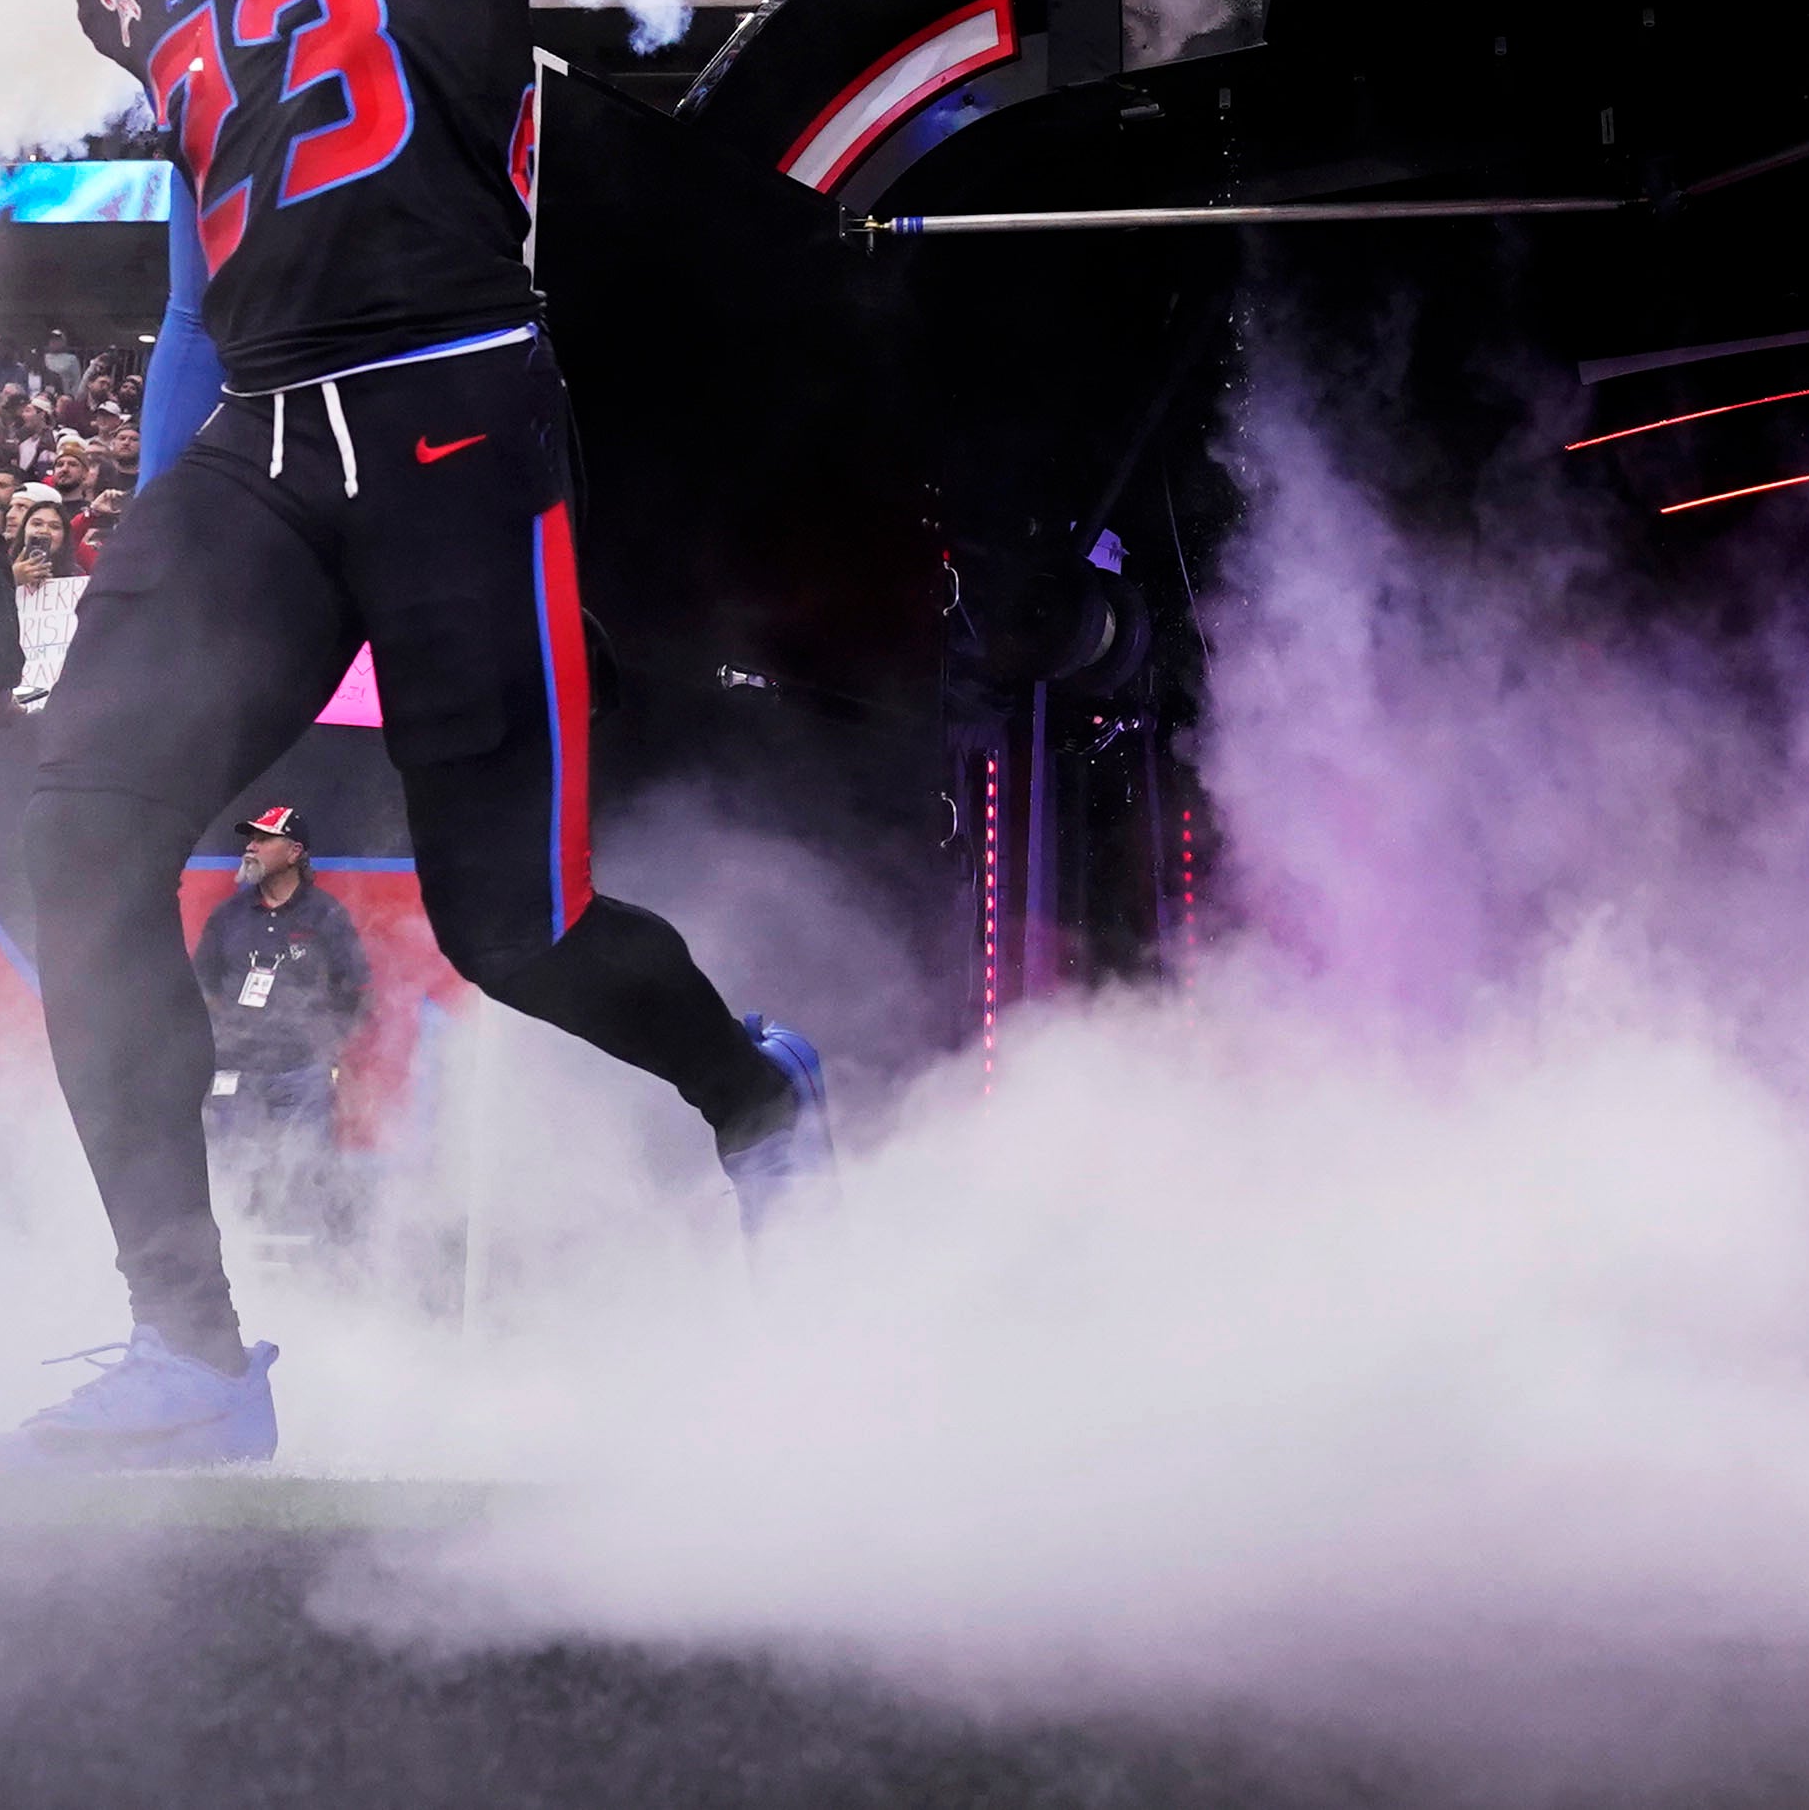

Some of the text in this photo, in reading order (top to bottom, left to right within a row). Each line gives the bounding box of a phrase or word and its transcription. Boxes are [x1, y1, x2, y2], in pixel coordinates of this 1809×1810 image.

[21, 578, 87, 613] MERR
[21, 610, 77, 649] RIST
[21, 661, 64, 687] RAV
